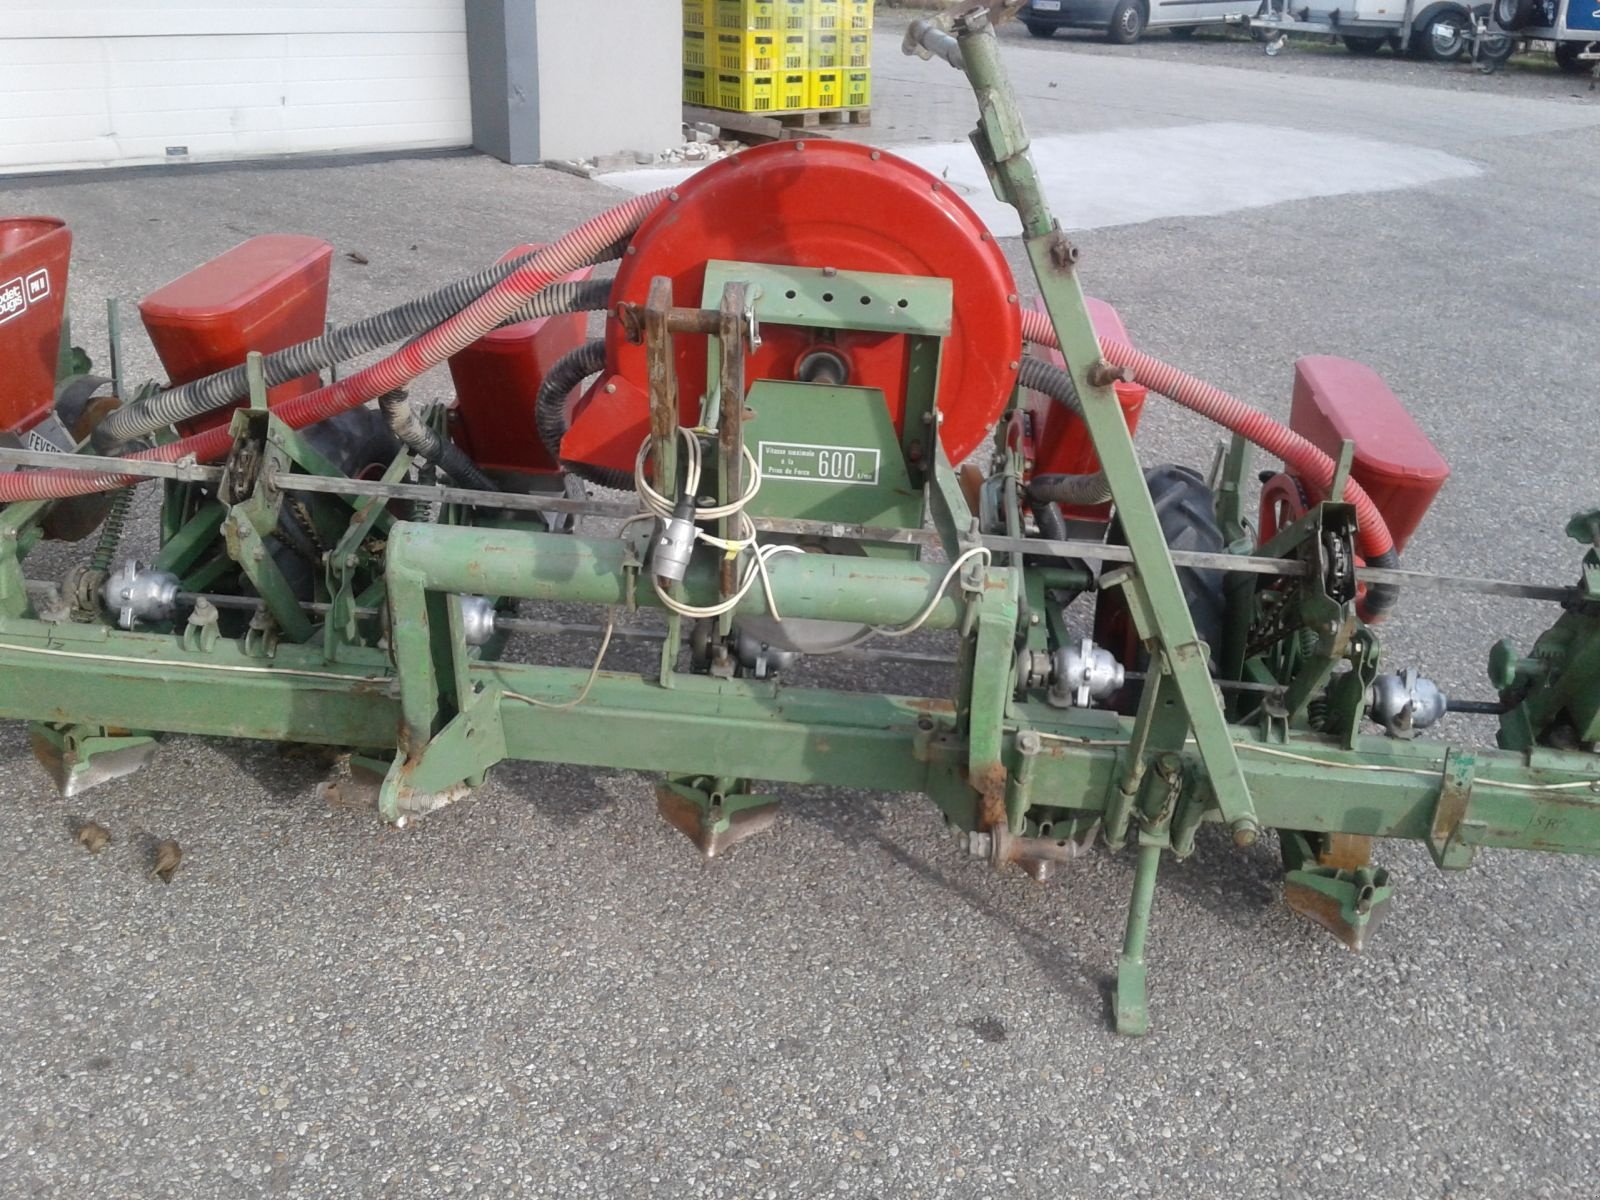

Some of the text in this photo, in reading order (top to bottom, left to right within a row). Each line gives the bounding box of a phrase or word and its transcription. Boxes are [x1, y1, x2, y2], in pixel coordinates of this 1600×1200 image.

[787, 449, 815, 457] maximale
[818, 450, 855, 479] 600
[794, 468, 810, 476] Force
